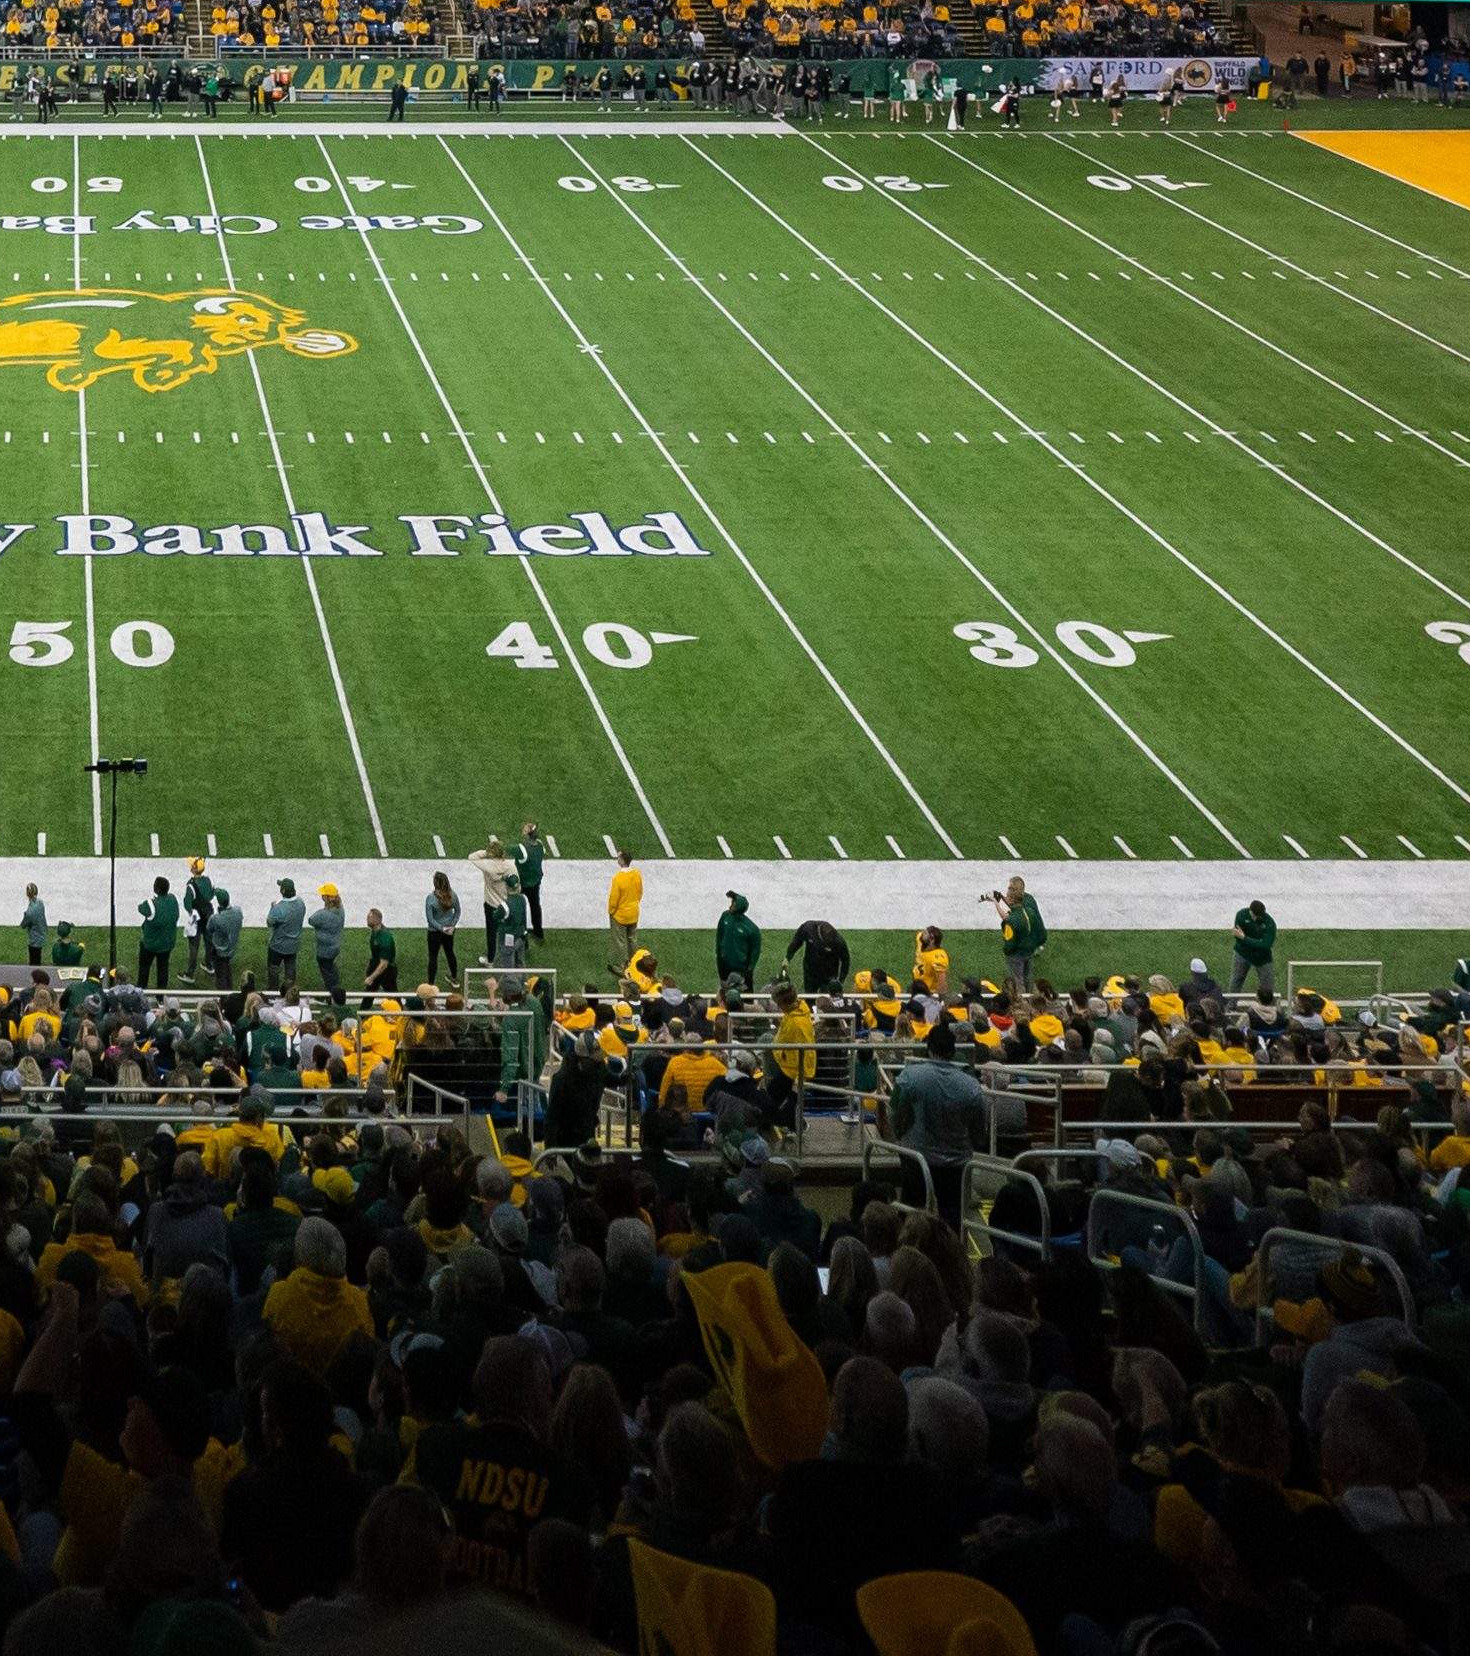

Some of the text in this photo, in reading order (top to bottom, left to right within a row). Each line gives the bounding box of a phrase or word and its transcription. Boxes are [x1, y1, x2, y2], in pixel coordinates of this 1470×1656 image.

[244, 63, 505, 90] CAMPION
[111, 209, 279, 237] City
[299, 213, 485, 236] Gate
[51, 509, 386, 560] Bank
[394, 509, 715, 560] Field
[6, 618, 177, 668] 50
[483, 619, 652, 670] 40
[950, 618, 1140, 670] 30
[454, 1455, 549, 1521] NDSU
